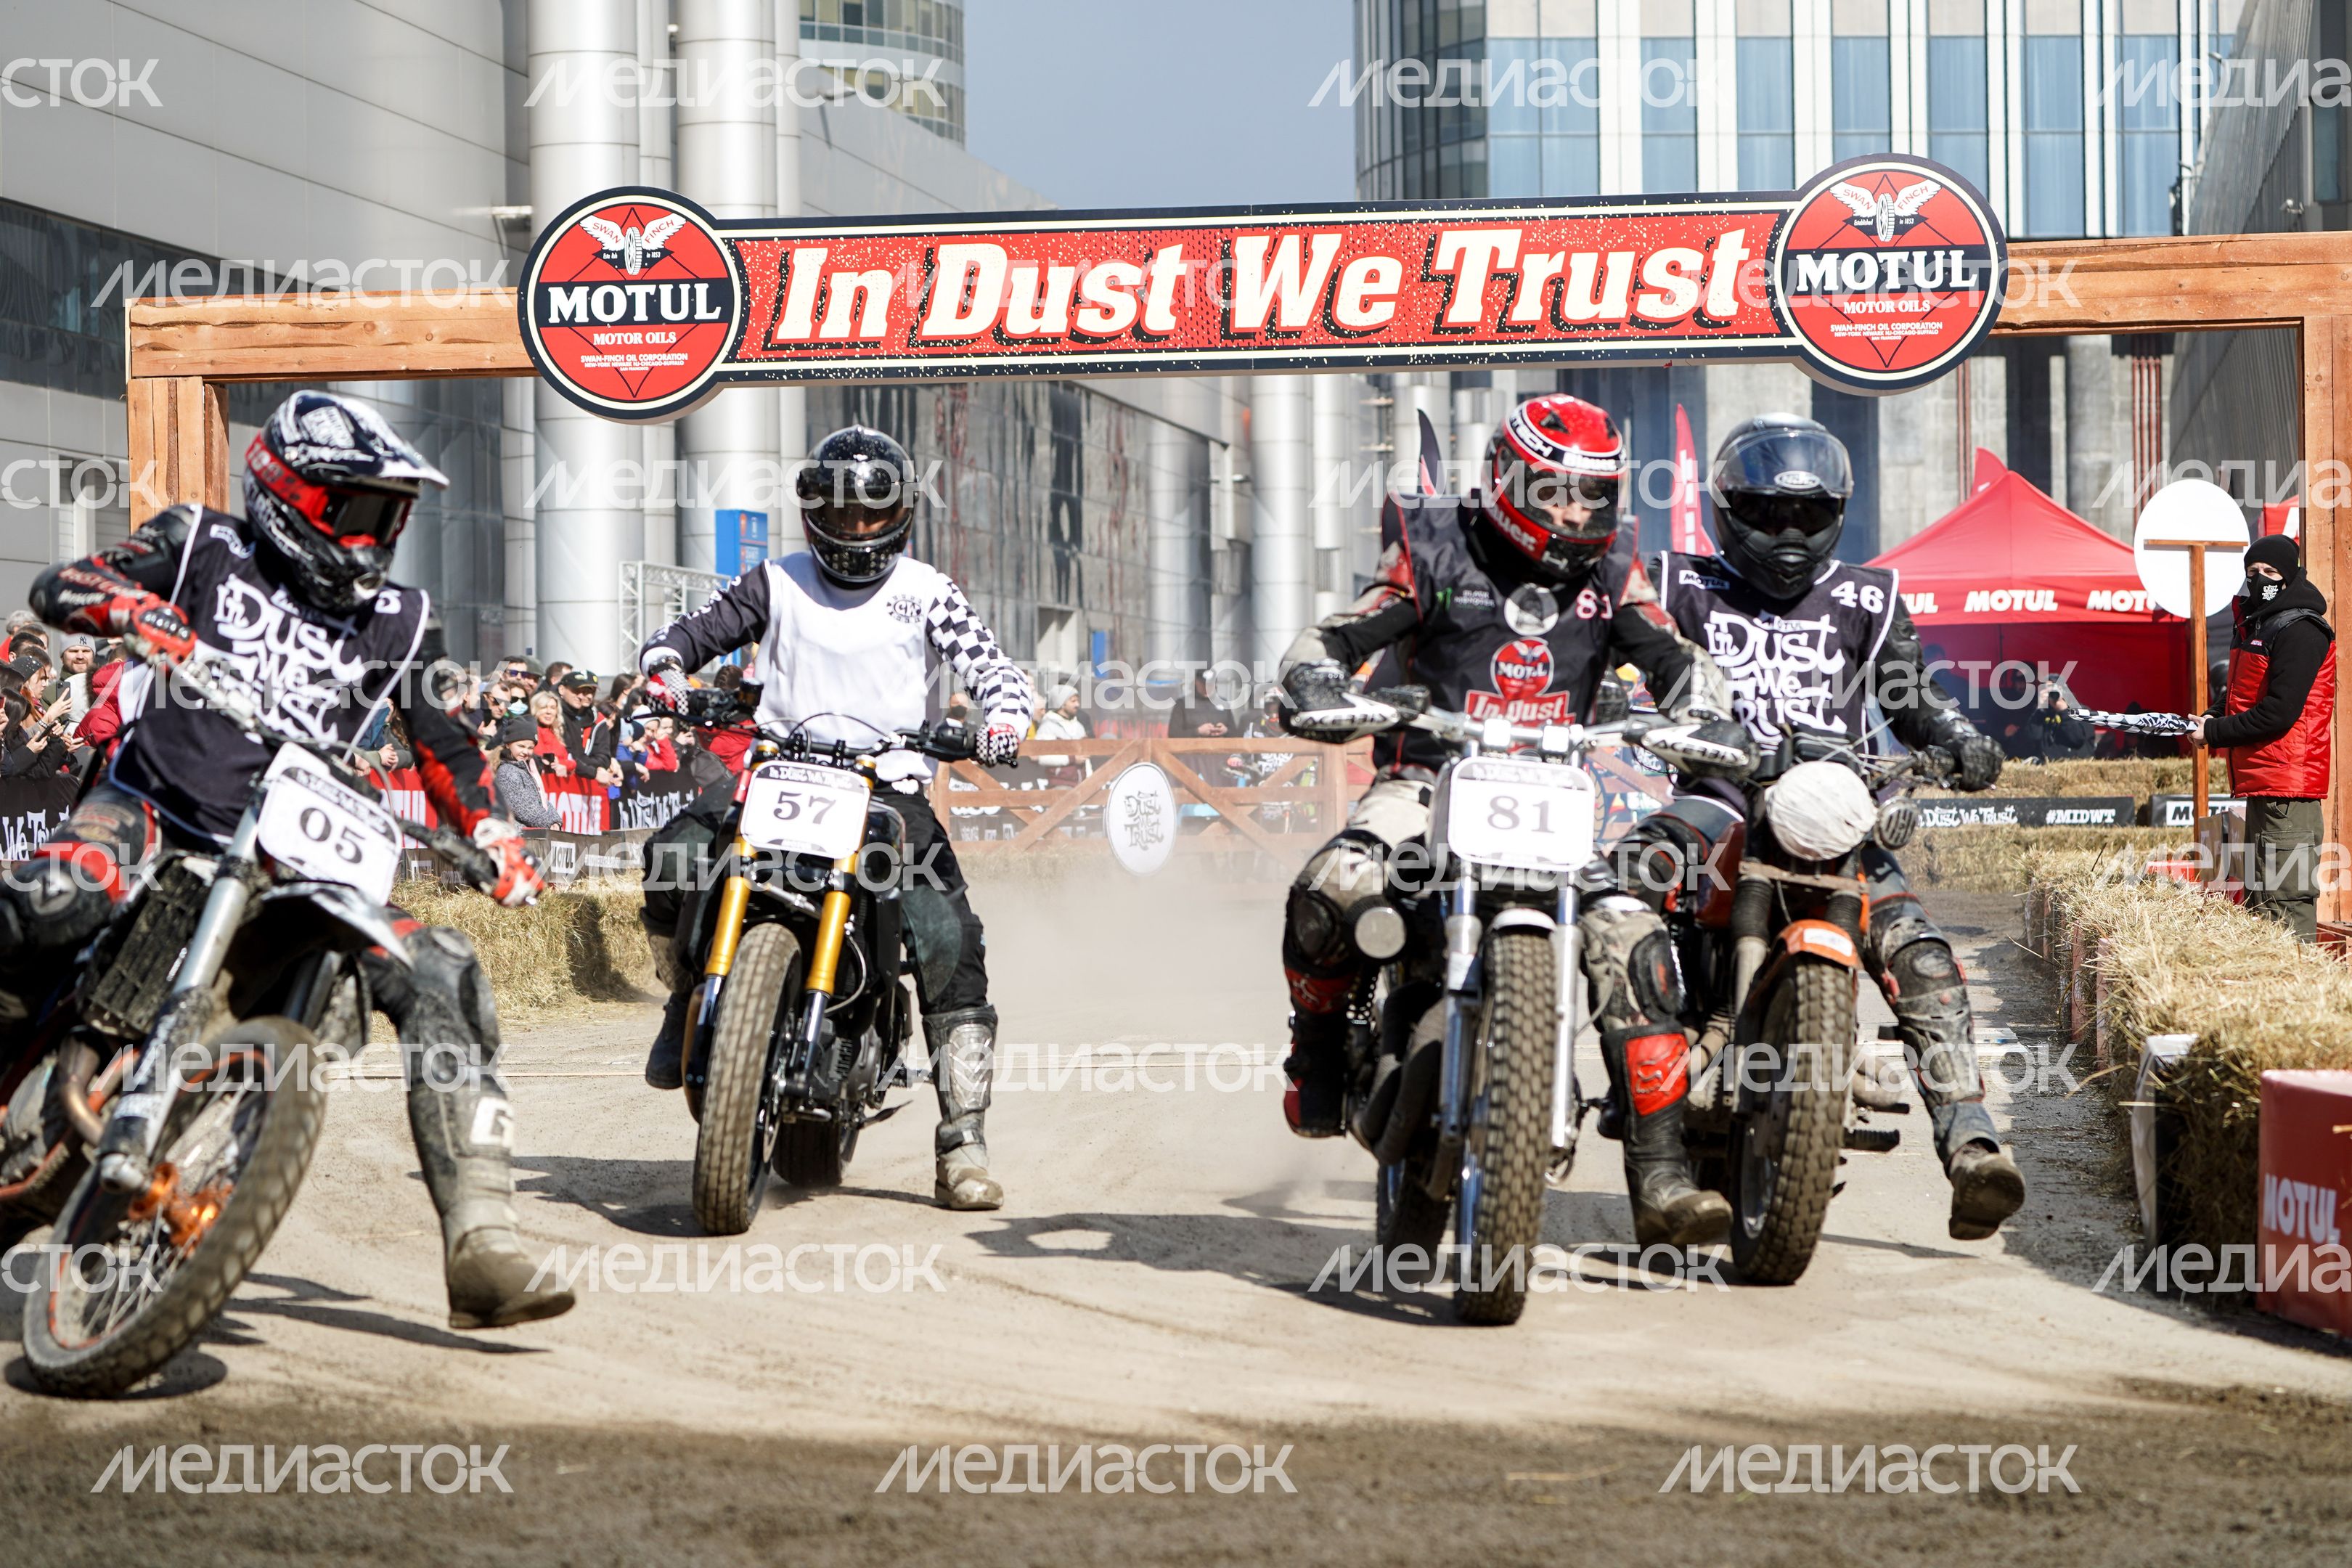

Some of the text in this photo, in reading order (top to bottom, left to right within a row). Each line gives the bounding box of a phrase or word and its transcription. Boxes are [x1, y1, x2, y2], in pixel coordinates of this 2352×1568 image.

[1843, 185, 1929, 211] SWAN FINCH
[592, 219, 674, 244] SWAN FINCH
[769, 228, 1751, 340] In Dust We Trust
[1795, 250, 1977, 292] MOTUL
[547, 282, 722, 324] MOTUL
[1843, 300, 1931, 314] MOTOR OILS
[593, 331, 677, 345] MOTOR OILS
[1830, 323, 1875, 332] SWAN-FINCH
[1890, 322, 1943, 330] CORPORATION
[581, 354, 625, 363] SWAN-FINCH
[1831, 580, 1885, 614] 46
[1964, 589, 2058, 613] MOTUL
[2086, 589, 2162, 611] MOT
[773, 791, 836, 825] 57
[1487, 795, 1556, 834] 81
[1923, 806, 1961, 828] Dust
[1959, 808, 1980, 825] We
[1978, 804, 2018, 825] Trust
[2045, 807, 2116, 825] #MIDWT
[299, 807, 367, 865] 05
[2263, 1172, 2341, 1247] MOTUL
